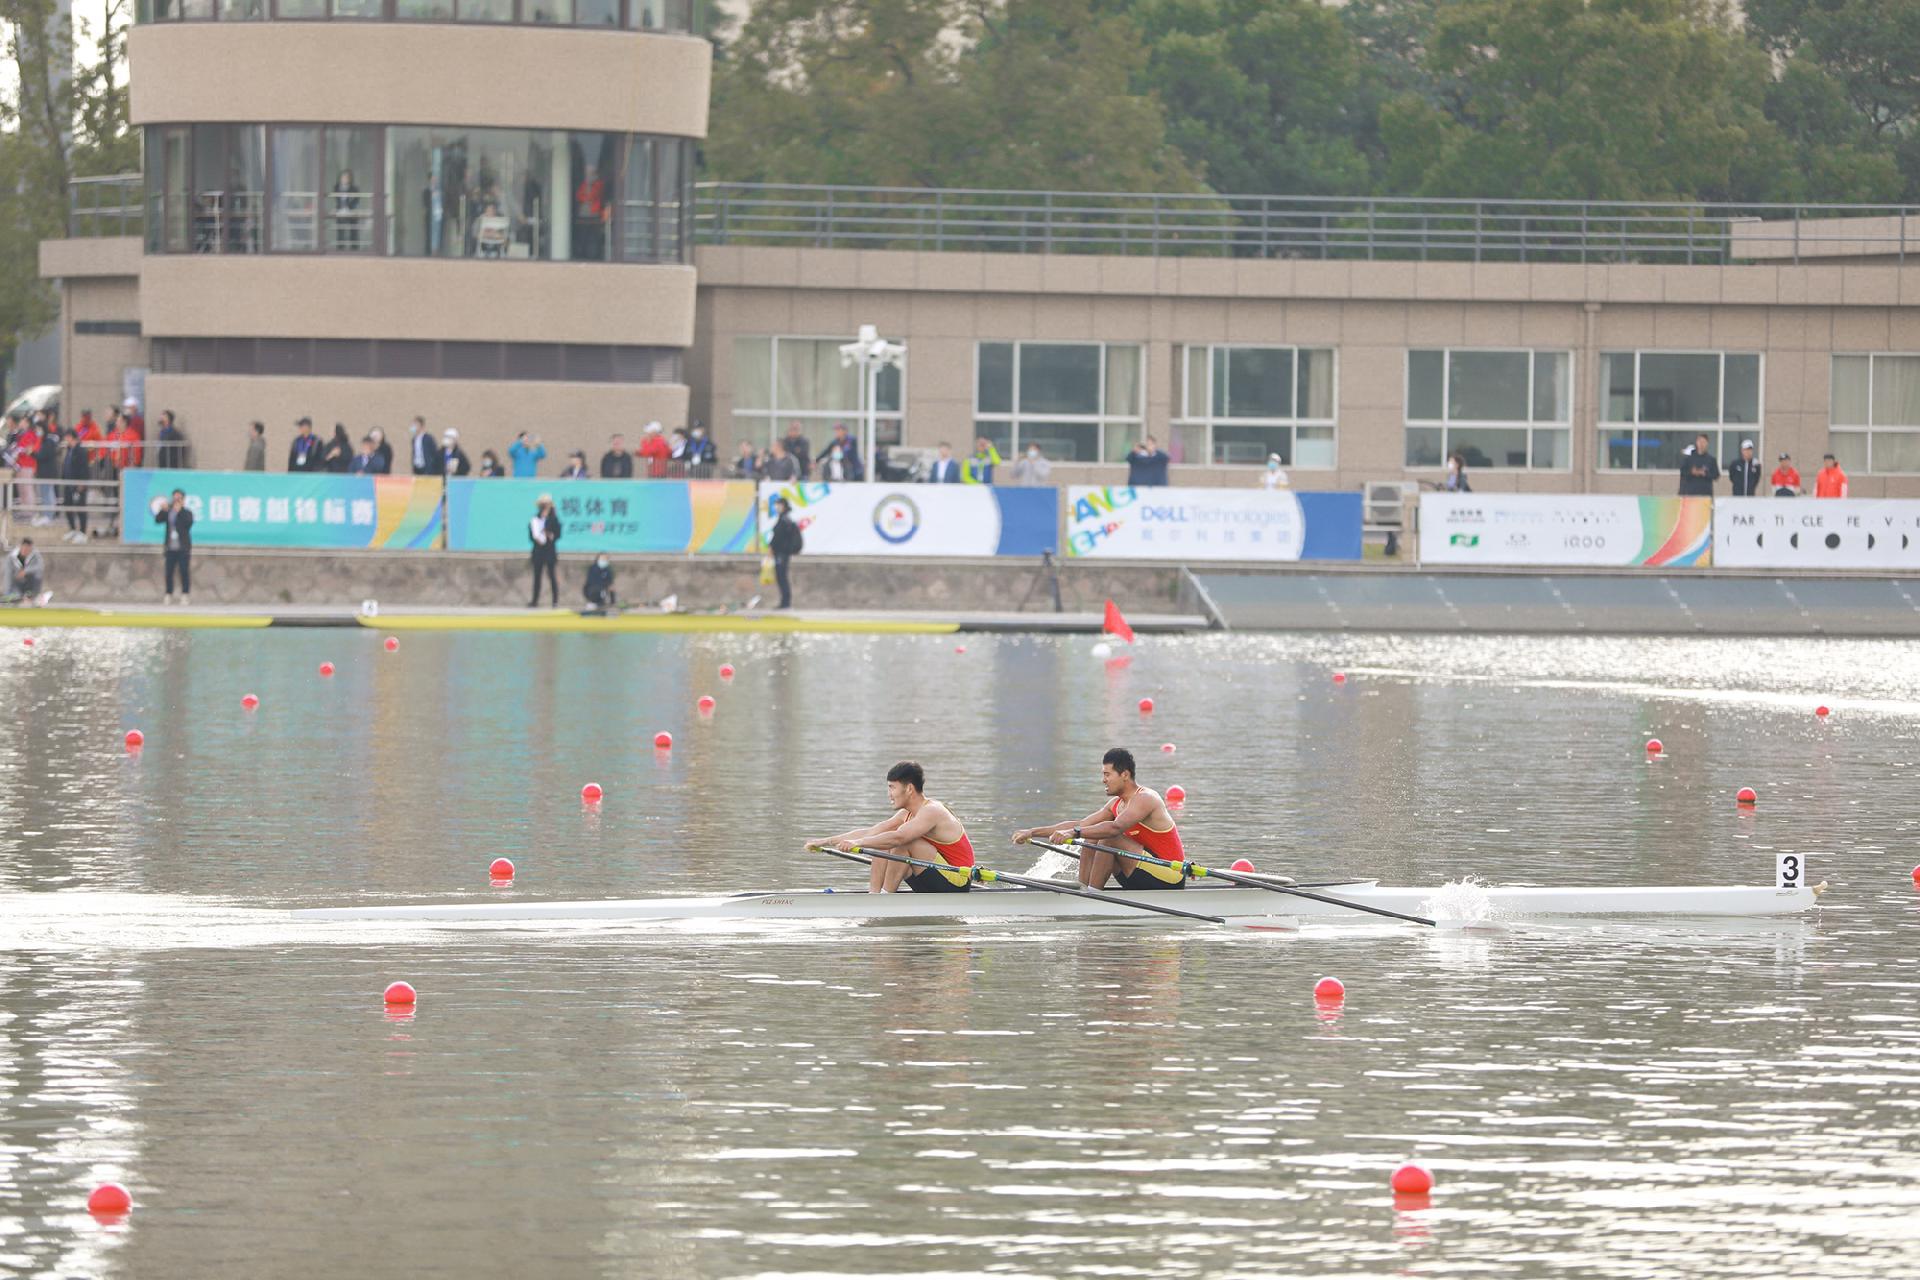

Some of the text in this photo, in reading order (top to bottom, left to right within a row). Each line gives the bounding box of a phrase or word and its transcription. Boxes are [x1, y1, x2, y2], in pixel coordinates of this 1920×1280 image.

[1190, 505, 1290, 527] Technologies
[1732, 516, 1755, 526] PAR
[1801, 516, 1823, 527] CLE
[1782, 855, 1799, 881] 3
